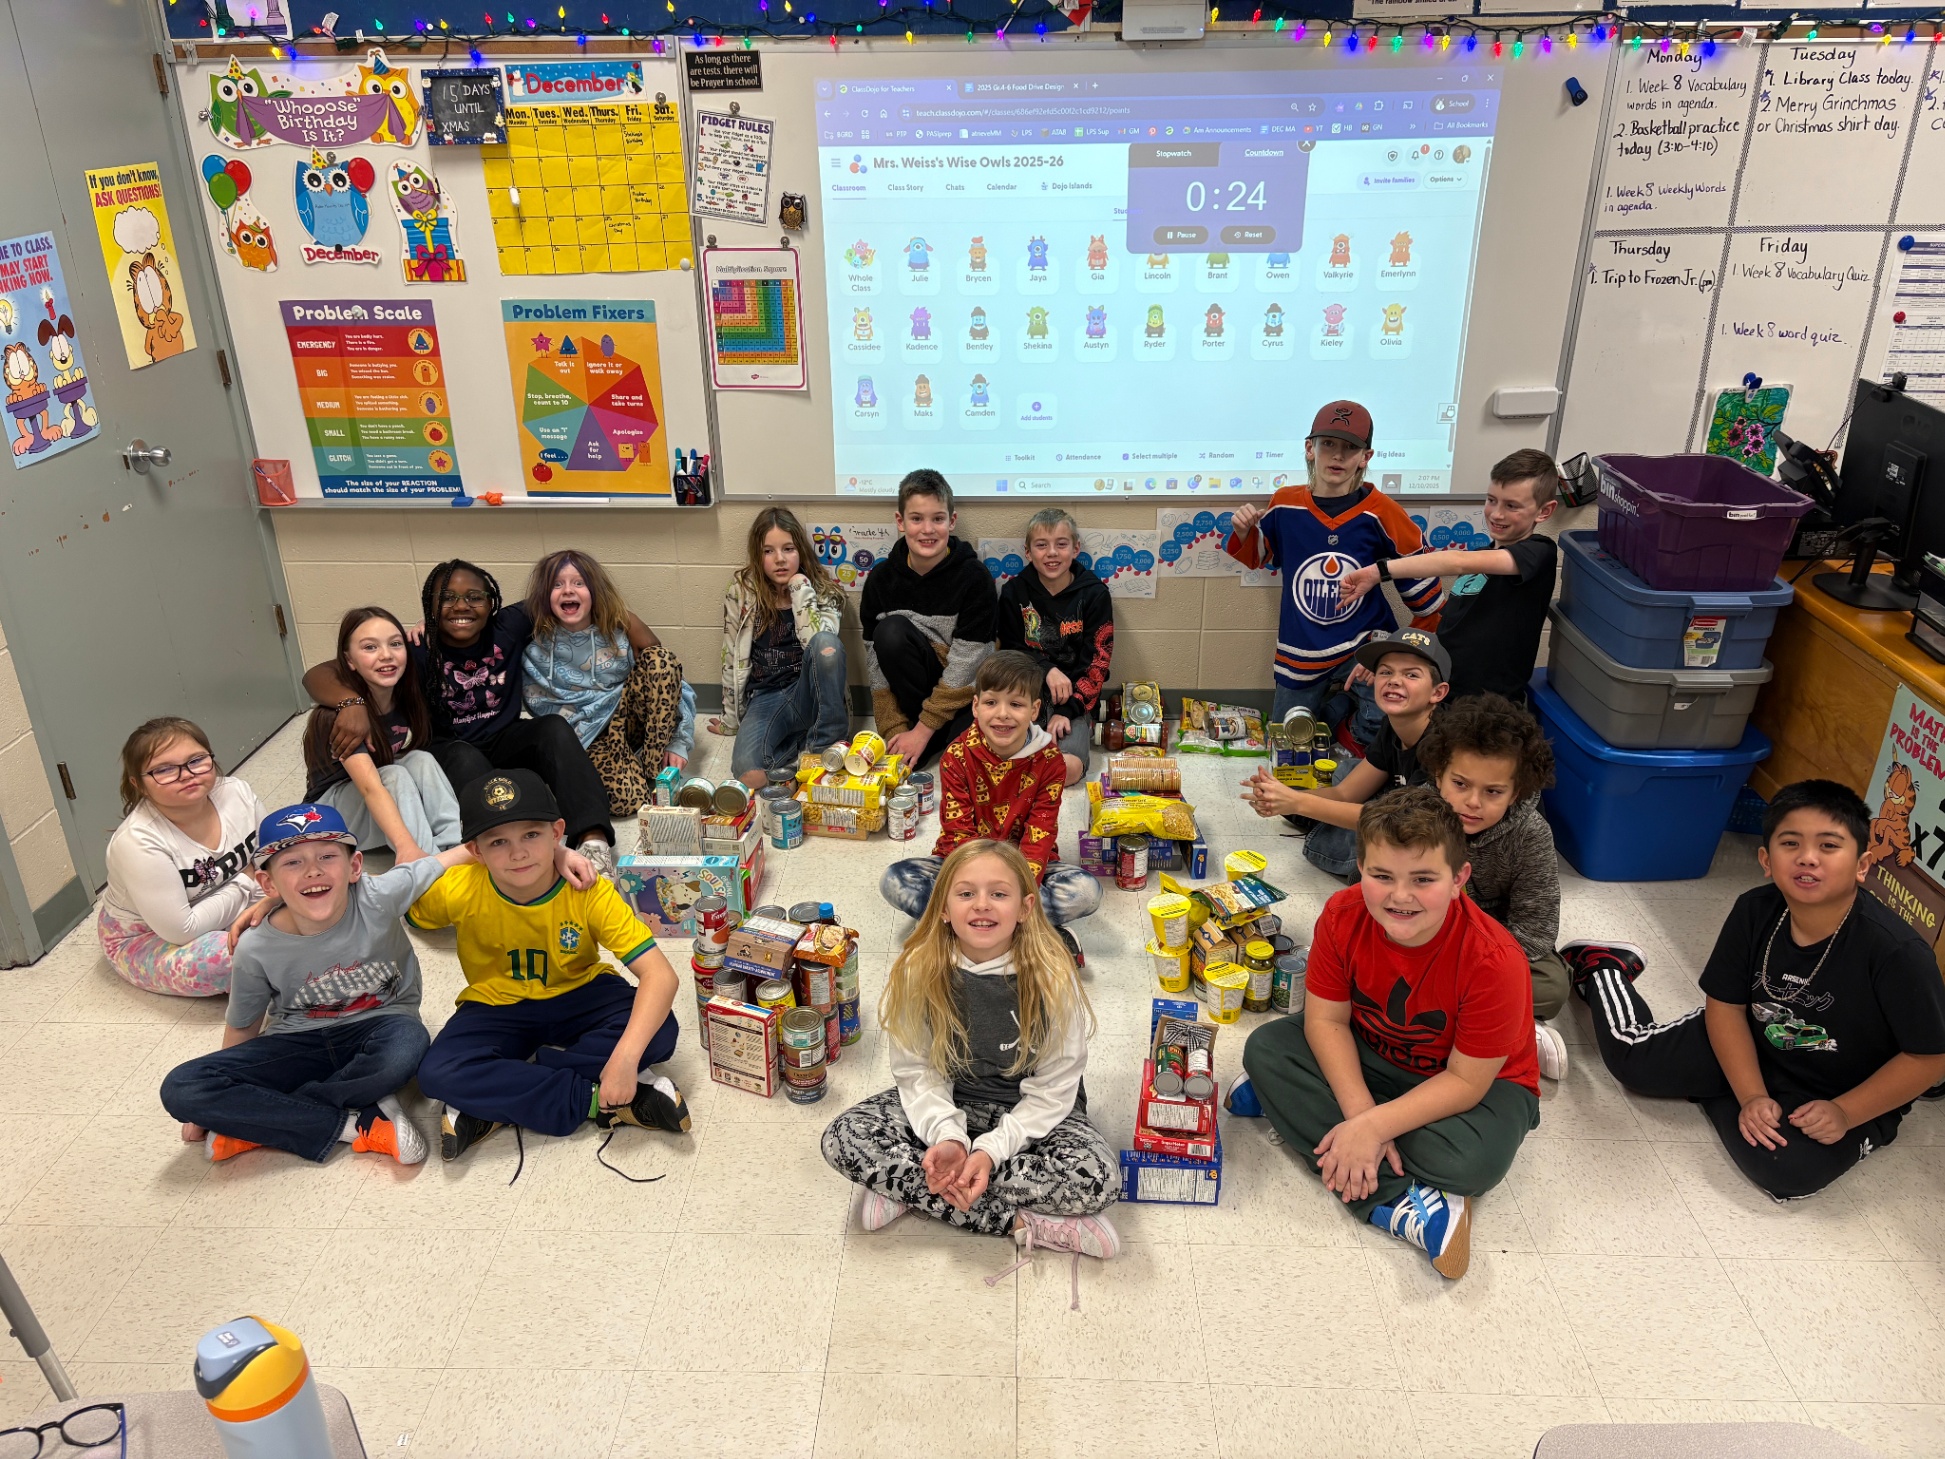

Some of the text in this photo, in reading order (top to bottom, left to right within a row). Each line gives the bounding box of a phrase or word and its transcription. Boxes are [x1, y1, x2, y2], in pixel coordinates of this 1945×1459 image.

[695, 53, 751, 65] As long as there
[1647, 49, 1702, 72] Monday
[1790, 47, 1856, 68] Tuesday
[723, 65, 743, 74] there
[744, 64, 758, 73] will
[525, 72, 624, 94] December
[690, 76, 759, 88] be Prayer in school.
[1626, 75, 1747, 98] 1. Week 8 Vocabulary
[1784, 71, 1834, 91] Library
[1838, 72, 1870, 84] Class
[1877, 68, 1914, 92] today.
[462, 83, 491, 96] DAYS
[454, 102, 485, 115] UNTIL
[506, 108, 530, 119] Mon.
[534, 108, 560, 118] Tues.
[563, 107, 588, 118] Wed.
[590, 106, 619, 117] Thurs.
[626, 105, 642, 116] Fri.
[654, 104, 674, 115] Sat.
[1627, 97, 1717, 117] words in agenda.
[1775, 96, 1817, 120] Merry
[1822, 94, 1896, 111] Grinchmas
[276, 114, 358, 134] Birthday
[441, 121, 470, 133] XMAS
[701, 115, 770, 134] FIDGET RULES
[1630, 120, 1686, 137] Basketball
[1688, 117, 1740, 139] practice
[1757, 114, 1900, 139] or Christmas shirt day.
[304, 128, 345, 142] Is It?
[1156, 149, 1192, 159] Stopwatch
[1244, 148, 1284, 157] Countdown
[1617, 142, 1651, 161] today
[873, 155, 1064, 169] Mrs. Weiss's Wise Owls 2025-26
[88, 168, 160, 189] If you don't know,
[887, 183, 924, 193] Class Story
[946, 183, 965, 191] Chats
[986, 182, 1017, 190] Calendar
[1606, 183, 1726, 199] 1. Week 8 Weekly Words
[95, 184, 162, 207] ASK QUESTIONS!
[1186, 179, 1267, 212] 0:24
[1604, 201, 1658, 216] in agenda.
[1177, 231, 1196, 240] Pause
[1244, 231, 1263, 239] Reset
[10, 238, 53, 258] TO CLASS.
[304, 247, 379, 262] December
[1609, 239, 1671, 263] Thursday
[1760, 237, 1808, 264] Friday
[23, 254, 48, 272] START
[716, 266, 762, 274] Multiplication
[28, 269, 54, 289] NOW.
[1266, 271, 1290, 280] Owen
[1323, 270, 1353, 280] Valkyrie
[1602, 269, 1626, 287] Trip
[1627, 270, 1642, 284] to
[1644, 269, 1683, 285] Frozen
[1683, 269, 1698, 286] Jr.
[1742, 264, 1772, 278] Week
[1775, 262, 1786, 278] 8
[1787, 267, 1845, 291] Vocabulary
[293, 305, 423, 320] Problem Scale
[513, 304, 645, 320] Problem Fixers
[1733, 322, 1765, 338] Week
[1767, 322, 1775, 337] 8
[1778, 325, 1807, 341] word
[297, 341, 336, 349] EMERGENCY
[906, 343, 938, 351] Kadence
[966, 342, 993, 352] Bentley
[1202, 339, 1225, 348] Porter
[1380, 338, 1402, 346] Olivia
[316, 369, 328, 377] BIG
[914, 409, 933, 417] Maks
[965, 409, 995, 417] Camden
[324, 429, 345, 437] SMALL
[1402, 633, 1430, 645] CATS
[1911, 725, 1939, 753] IS THE
[1877, 865, 1935, 928] THINKING
[507, 948, 547, 987] 10
